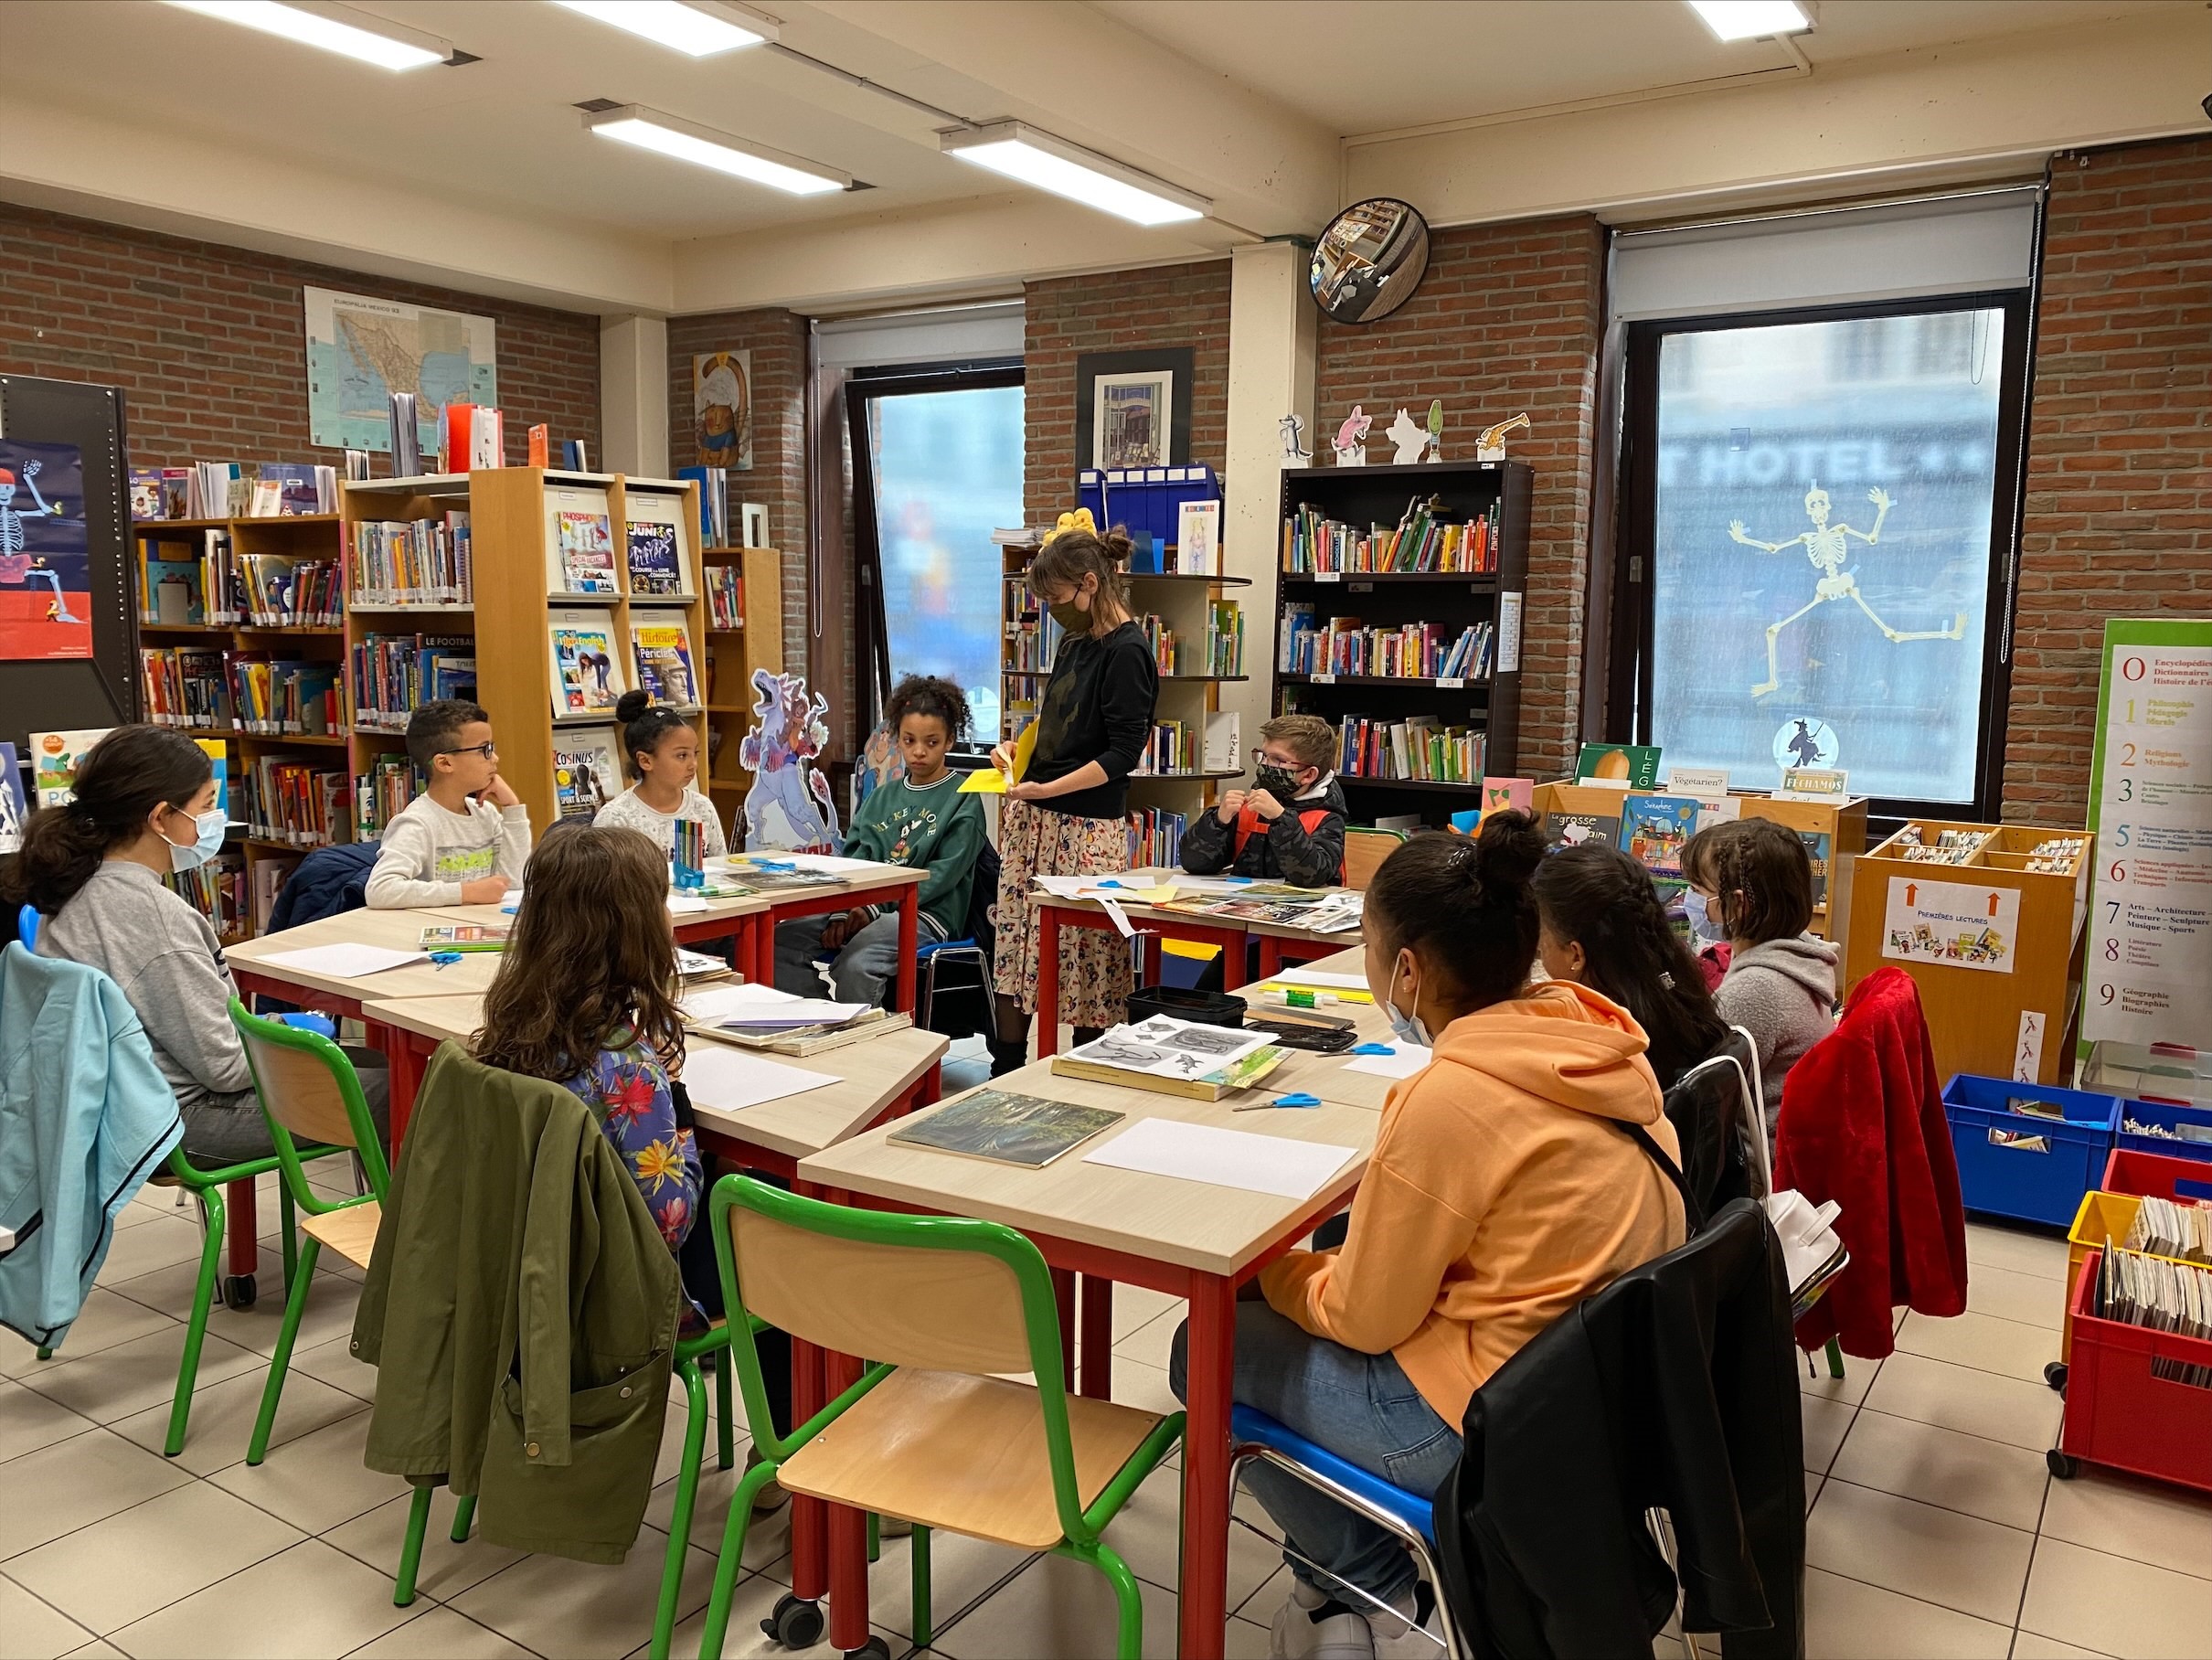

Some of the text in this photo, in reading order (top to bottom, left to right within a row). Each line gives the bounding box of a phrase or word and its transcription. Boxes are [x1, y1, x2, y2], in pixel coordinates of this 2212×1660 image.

[334, 299, 367, 308] EUROPALIA
[368, 304, 389, 313] MEXICO
[1702, 441, 1903, 484] HOTEL
[426, 637, 435, 645] LE
[642, 632, 676, 644] Histoire
[2154, 668, 2209, 676] Dictionnaires
[2154, 677, 2188, 686] Histoire
[2148, 698, 2195, 708] Philosophie
[556, 751, 592, 765] COSINUS
[2121, 742, 2136, 766] 2
[2144, 750, 2181, 758] Religions
[2144, 759, 2190, 768] Mythologie
[1674, 776, 1723, 788] Végétarien?
[2118, 779, 2132, 802] 3
[559, 795, 574, 804] SPORT
[872, 805, 917, 833] MICKEY
[1558, 815, 1597, 826] grosse
[2115, 825, 2131, 847] 5
[2111, 859, 2126, 882] 6
[2106, 901, 2121, 924] 7
[2128, 903, 2145, 911] Arts
[2154, 906, 2207, 916] Architecture
[1918, 910, 1988, 925] PREMIÈRES LECTURES
[2127, 911, 2161, 921] Peinture
[2170, 916, 2210, 926] Sculpture
[2127, 920, 2161, 931] Musique
[2168, 925, 2196, 934] Sports
[2105, 938, 2120, 962] 8
[2099, 984, 2115, 1006] 9
[2122, 987, 2170, 1000] Géographie
[2122, 996, 2170, 1008] Biographies
[2122, 1006, 2154, 1016] Histoire
